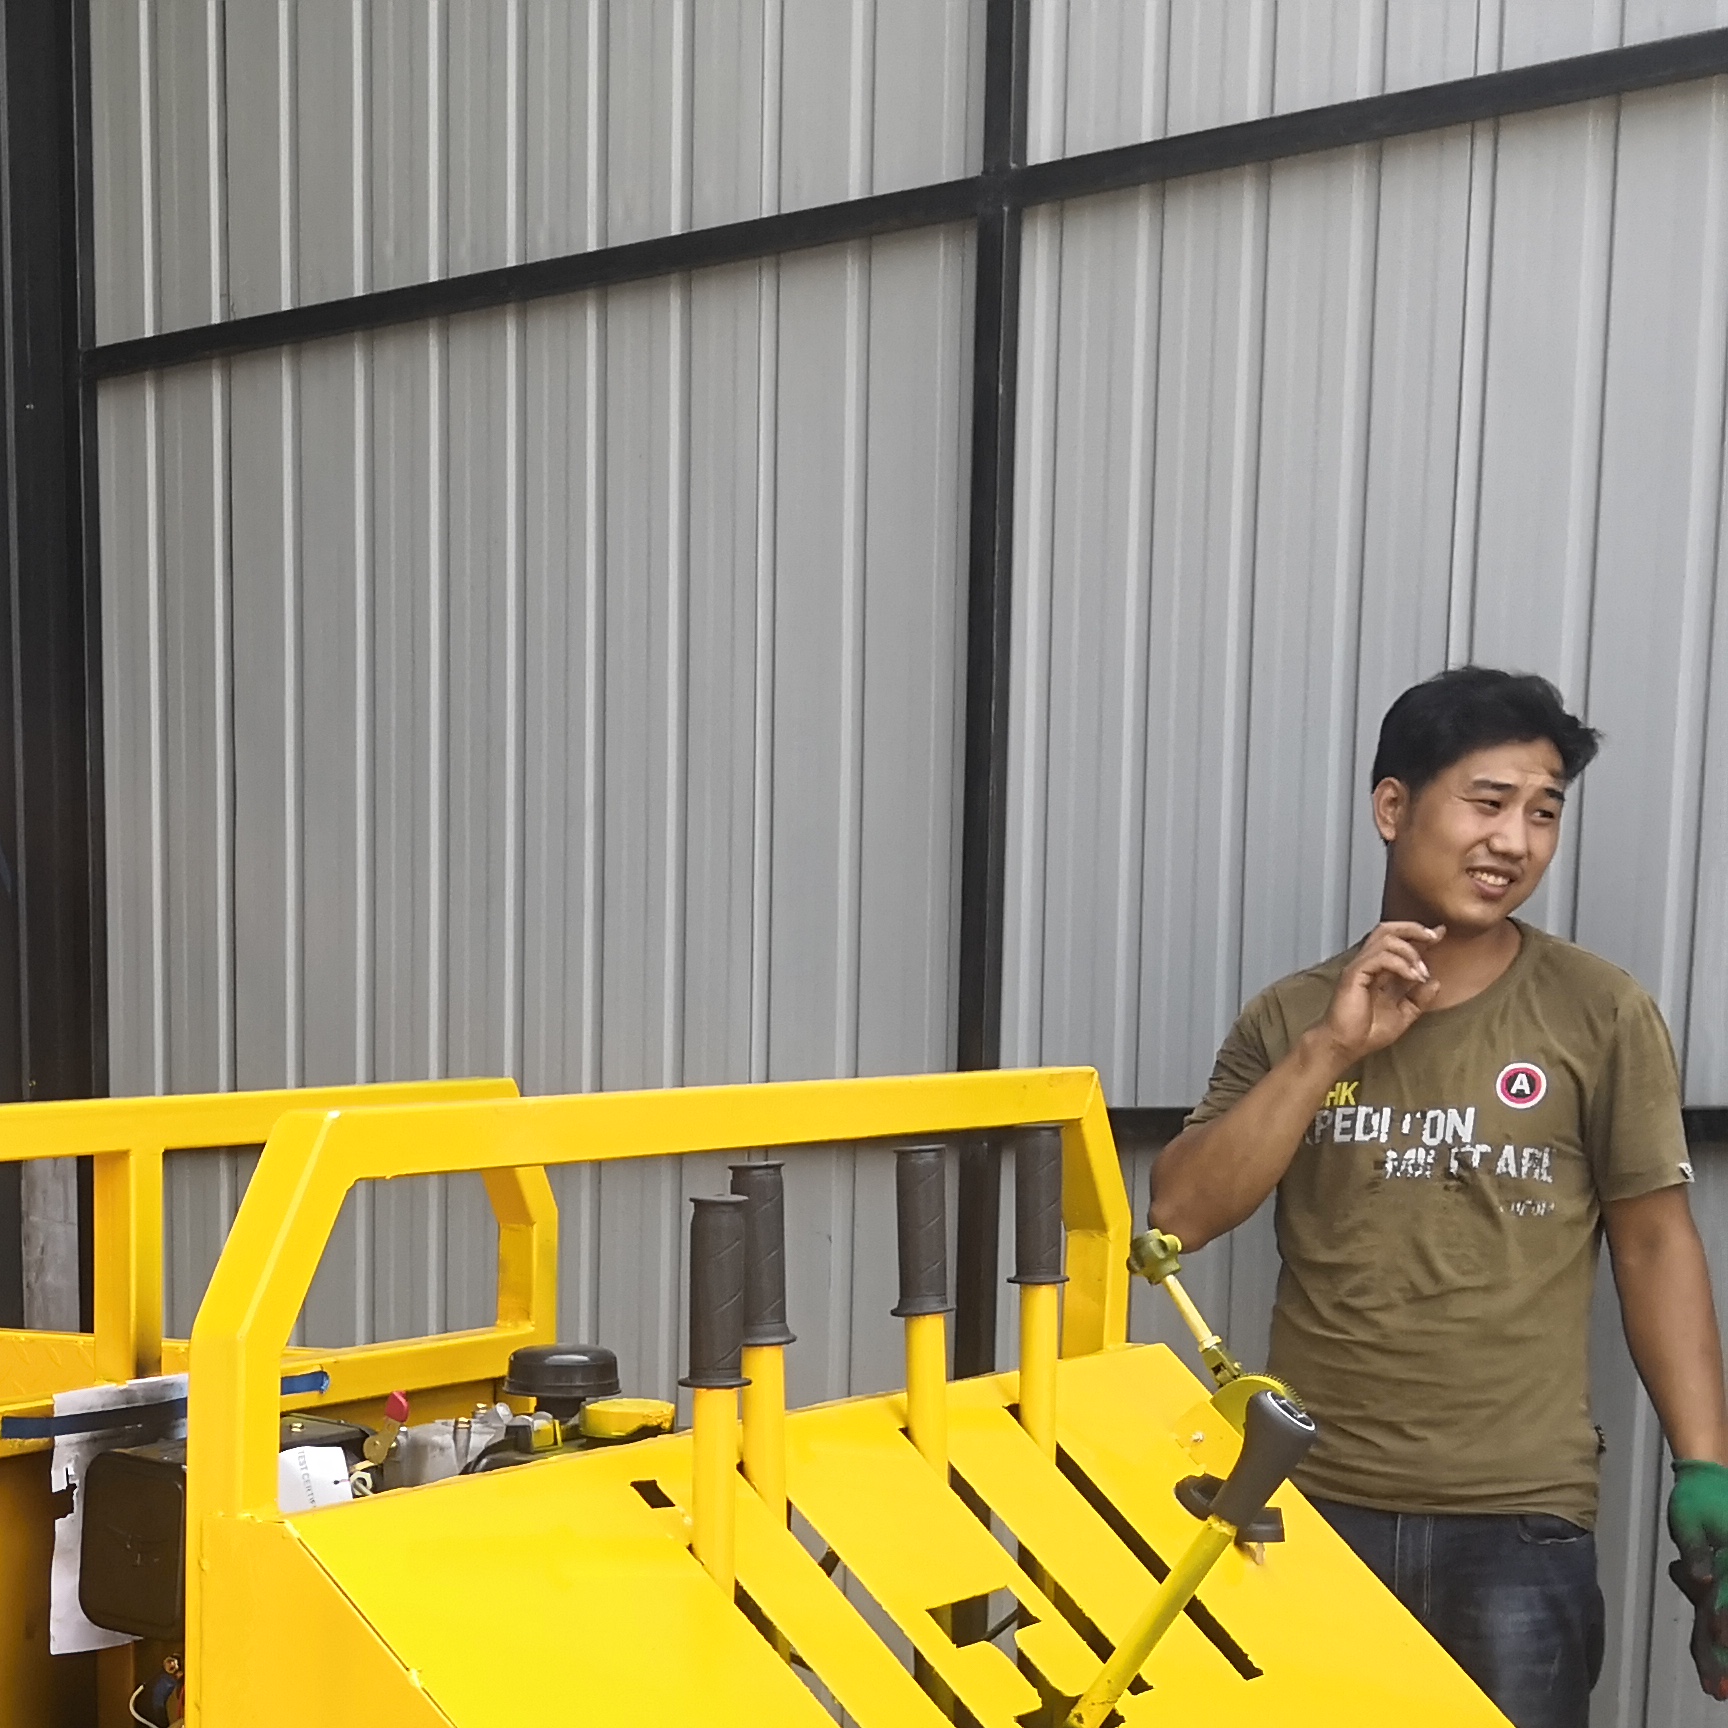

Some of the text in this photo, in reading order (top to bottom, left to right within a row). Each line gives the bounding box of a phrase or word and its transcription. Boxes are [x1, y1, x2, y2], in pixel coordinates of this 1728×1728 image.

[1323, 1081, 1359, 1106] HK
[1511, 1073, 1531, 1095] A
[297, 1449, 309, 1471] TEST
